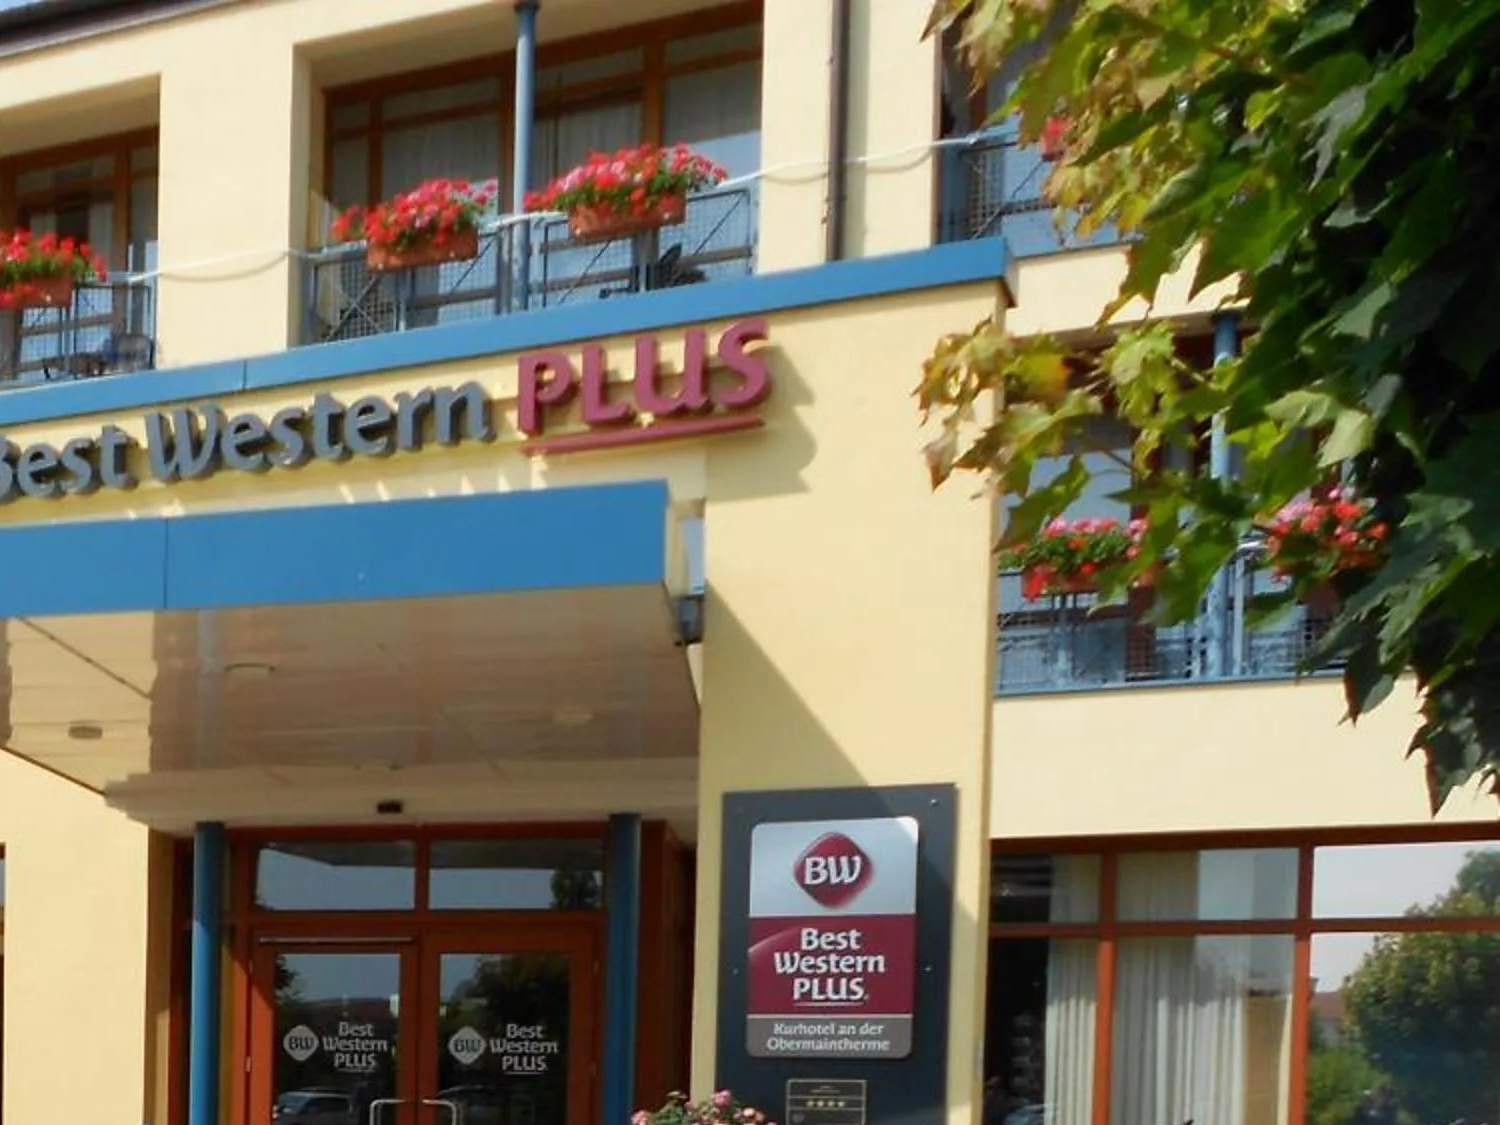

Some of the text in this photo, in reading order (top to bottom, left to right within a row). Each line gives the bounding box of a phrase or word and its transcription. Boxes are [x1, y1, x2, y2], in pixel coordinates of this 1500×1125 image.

[144, 381, 498, 482] Western
[517, 318, 769, 438] PLUS
[803, 856, 862, 886] BW
[801, 928, 861, 951] Best
[774, 952, 885, 974] Western
[793, 978, 865, 1001] PLUS
[338, 1022, 373, 1037] Best
[506, 1023, 544, 1039] Best
[773, 1022, 885, 1036] Kurhotel an der
[323, 1037, 388, 1051] Western
[490, 1039, 559, 1055] Western
[766, 1037, 891, 1052] Obermaintherme
[334, 1053, 377, 1068] PLUS
[502, 1056, 547, 1071] PLUS
